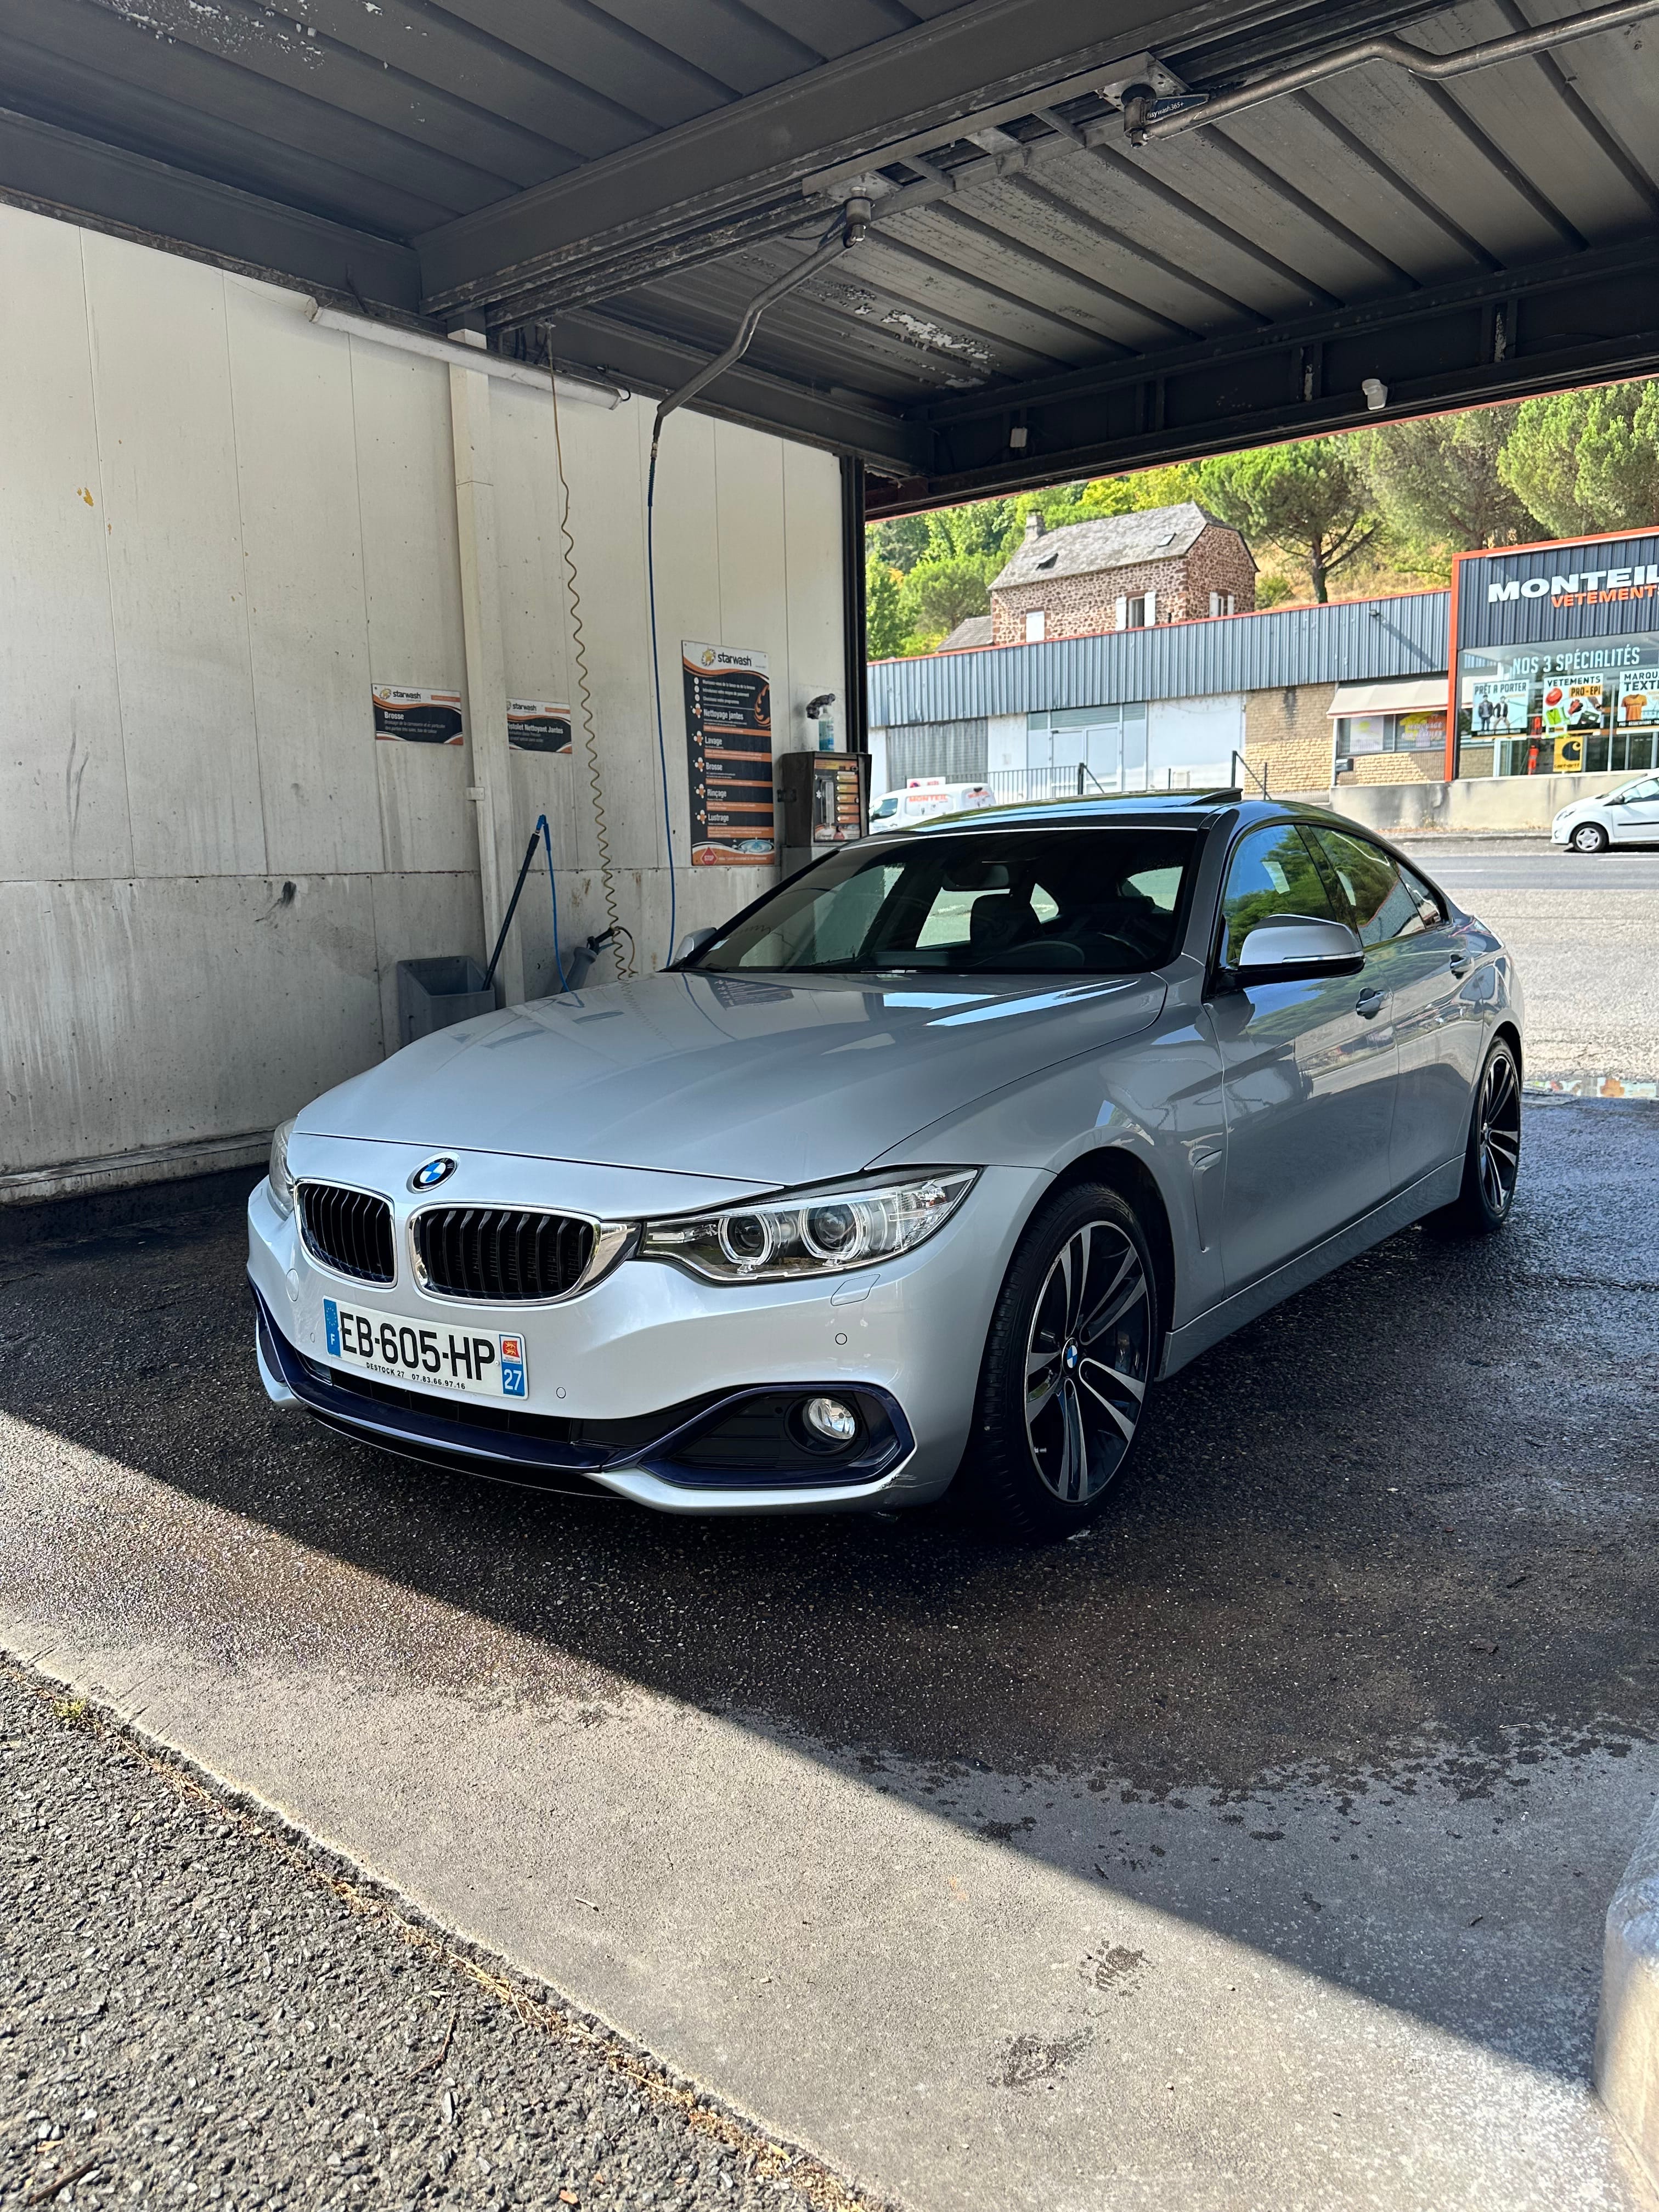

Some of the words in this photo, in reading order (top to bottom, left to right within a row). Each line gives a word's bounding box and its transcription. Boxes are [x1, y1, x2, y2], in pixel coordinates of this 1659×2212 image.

[1488, 564, 1659, 603] MONTEIL
[1551, 584, 1659, 608] VETEMENT
[718, 652, 752, 667] starwash
[1513, 657, 1539, 675] NOS
[1543, 655, 1551, 673] 3
[1556, 644, 1641, 672] SPÉCIALITÉS
[1547, 675, 1601, 687] VETEMENTS
[1624, 672, 1659, 681] MARQU
[1500, 682, 1527, 693] PORTER
[1571, 686, 1584, 697] PRO
[1590, 685, 1601, 696] EPI
[393, 690, 421, 699] starwash
[512, 703, 537, 712] starwash
[384, 712, 404, 720] Brosse
[703, 709, 729, 720] Nettoyage
[729, 711, 744, 720] jantes
[508, 723, 524, 731] istolet
[705, 736, 723, 746] Lavage
[706, 762, 723, 771] Brosse
[707, 788, 727, 798] Rinçage
[708, 814, 729, 823] Lustrage
[330, 1333, 336, 1345] F
[340, 1311, 496, 1381] EB-605-HP
[366, 1362, 396, 1376] DESTOCK
[411, 1374, 466, 1390] 07.83.66.97.16
[503, 1368, 523, 1391] 27
